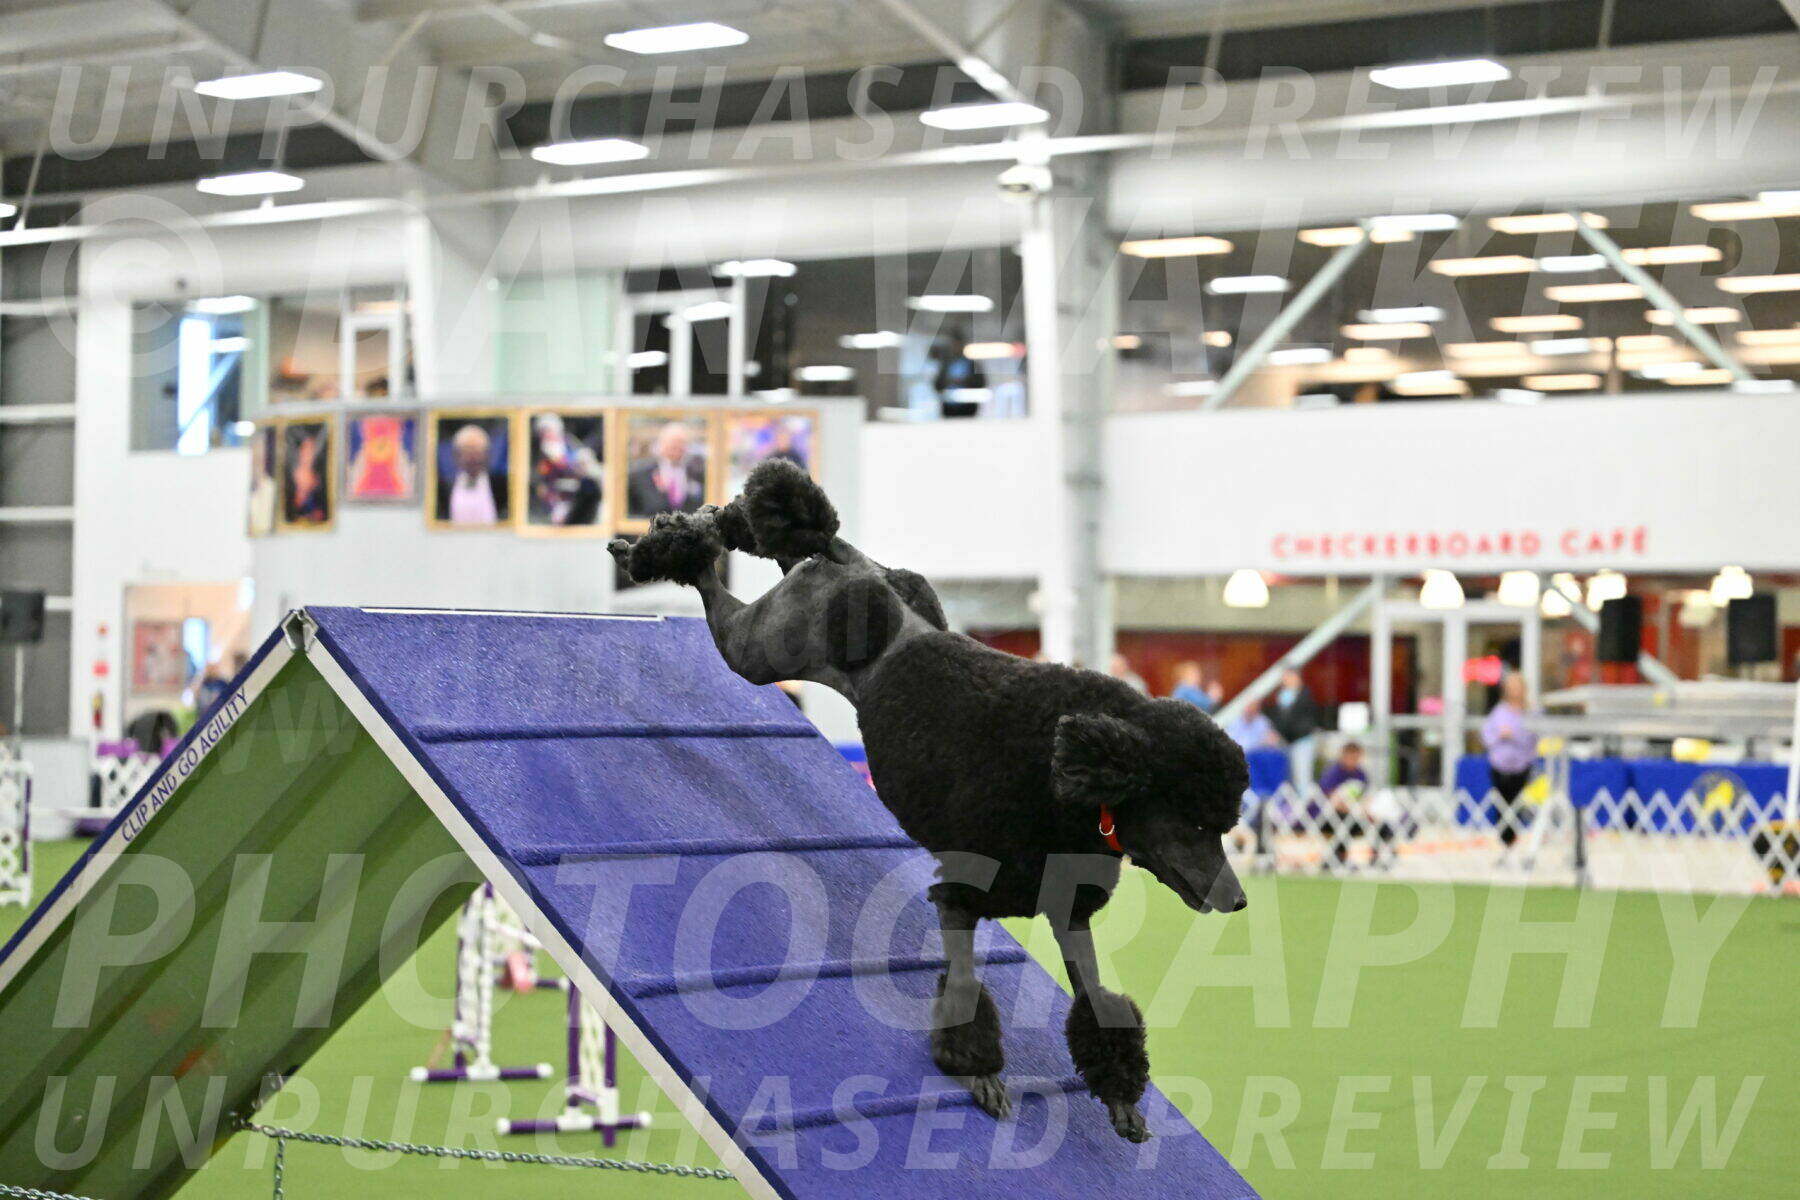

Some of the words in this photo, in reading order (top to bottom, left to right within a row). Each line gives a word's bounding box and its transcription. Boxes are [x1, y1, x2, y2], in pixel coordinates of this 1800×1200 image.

[1271, 532, 1541, 559] CHECKERBOARD
[1559, 525, 1649, 556] CAFÉ
[121, 803, 149, 842] CLIP
[151, 773, 178, 812] AND
[178, 747, 199, 777] GO
[200, 686, 249, 754] AGILITY
